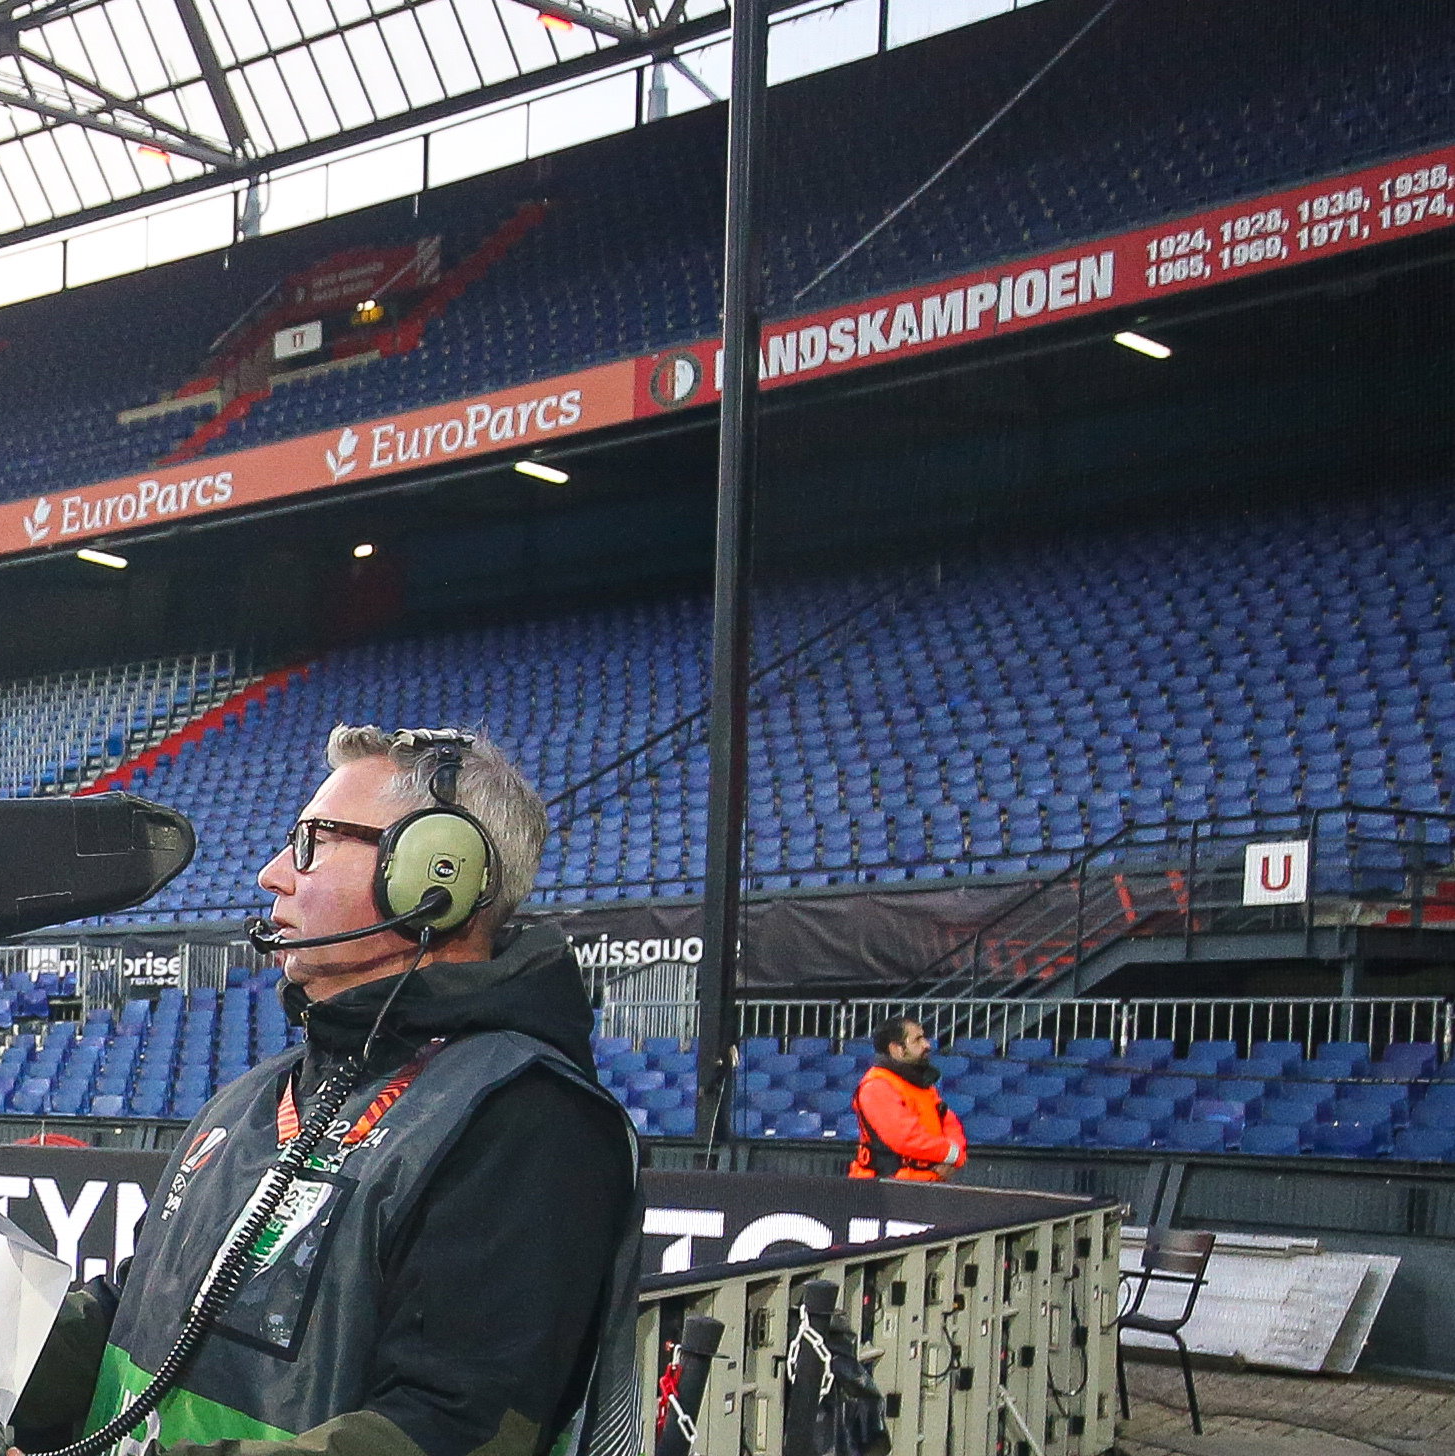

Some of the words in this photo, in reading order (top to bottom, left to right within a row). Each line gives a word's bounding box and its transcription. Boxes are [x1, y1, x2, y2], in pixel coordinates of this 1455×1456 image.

[715, 251, 1115, 391] NDSKAMPIOEN
[369, 388, 583, 468] EuroParcs
[60, 472, 234, 535] EuroParcs
[1260, 853, 1292, 891] U
